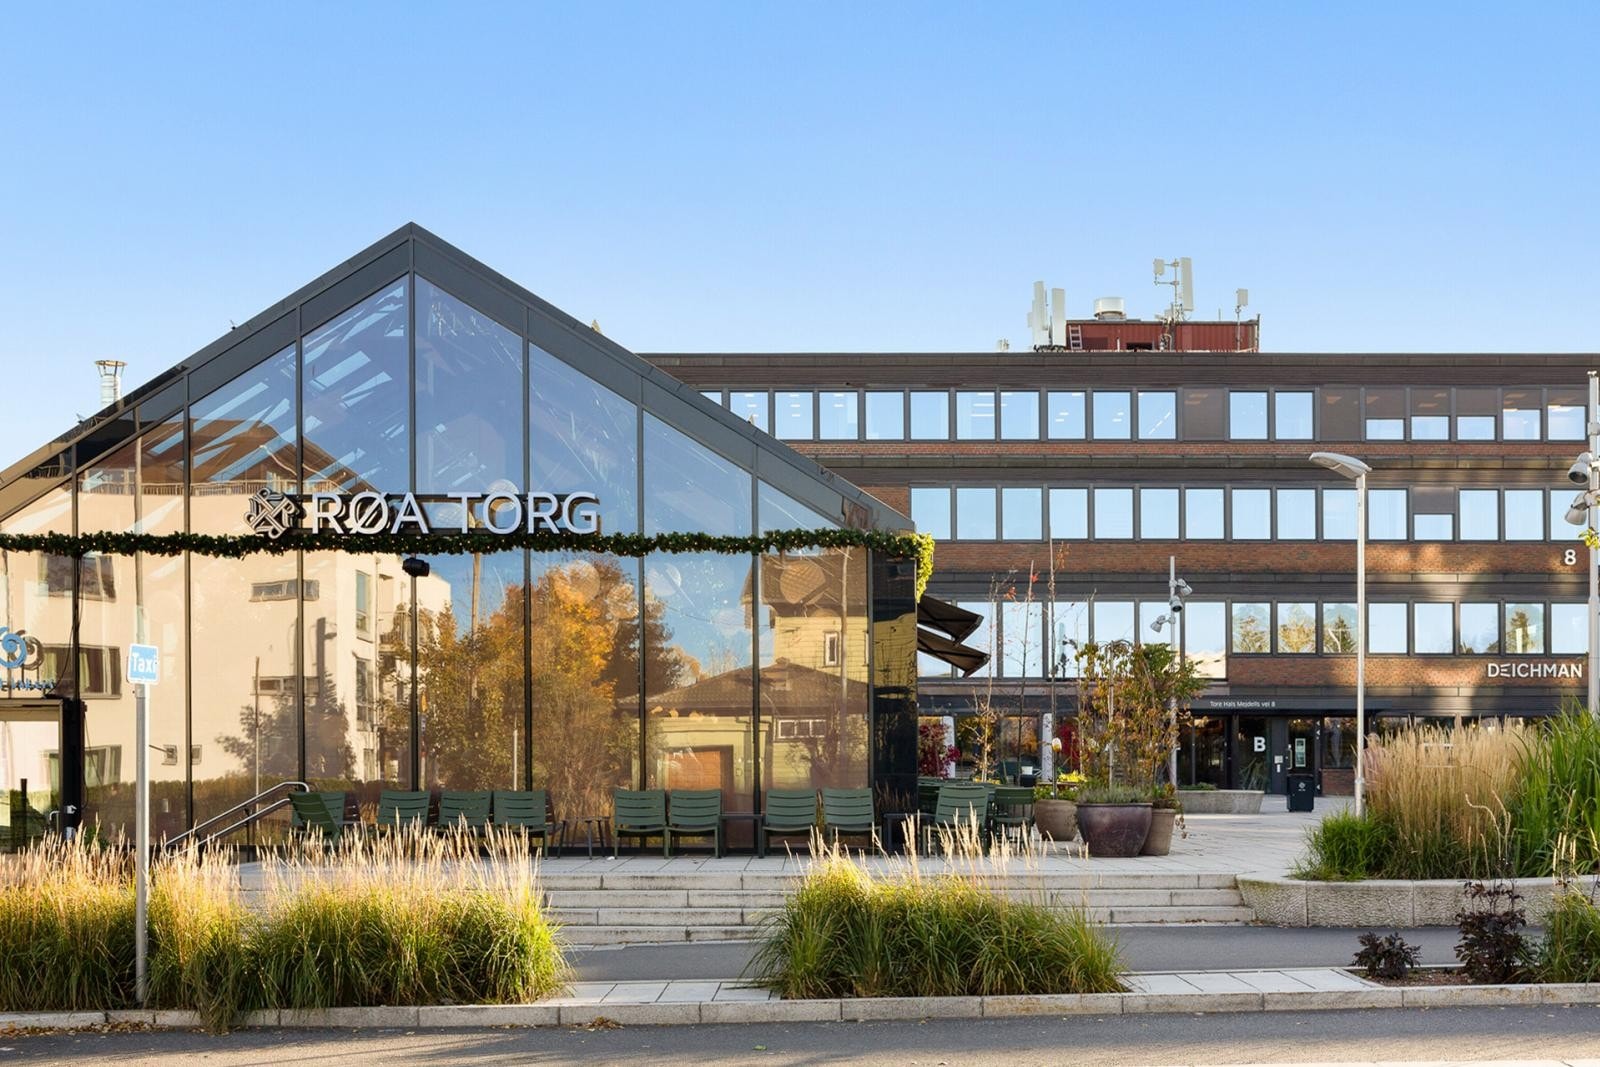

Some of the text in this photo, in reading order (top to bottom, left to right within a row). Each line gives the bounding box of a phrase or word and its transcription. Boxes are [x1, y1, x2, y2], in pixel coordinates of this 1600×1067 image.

[310, 491, 598, 535] RØA TORG
[1564, 549, 1577, 566] 8
[132, 652, 157, 673] Taxi
[1487, 663, 1583, 678] DEICHMAN
[1253, 736, 1266, 752] B
